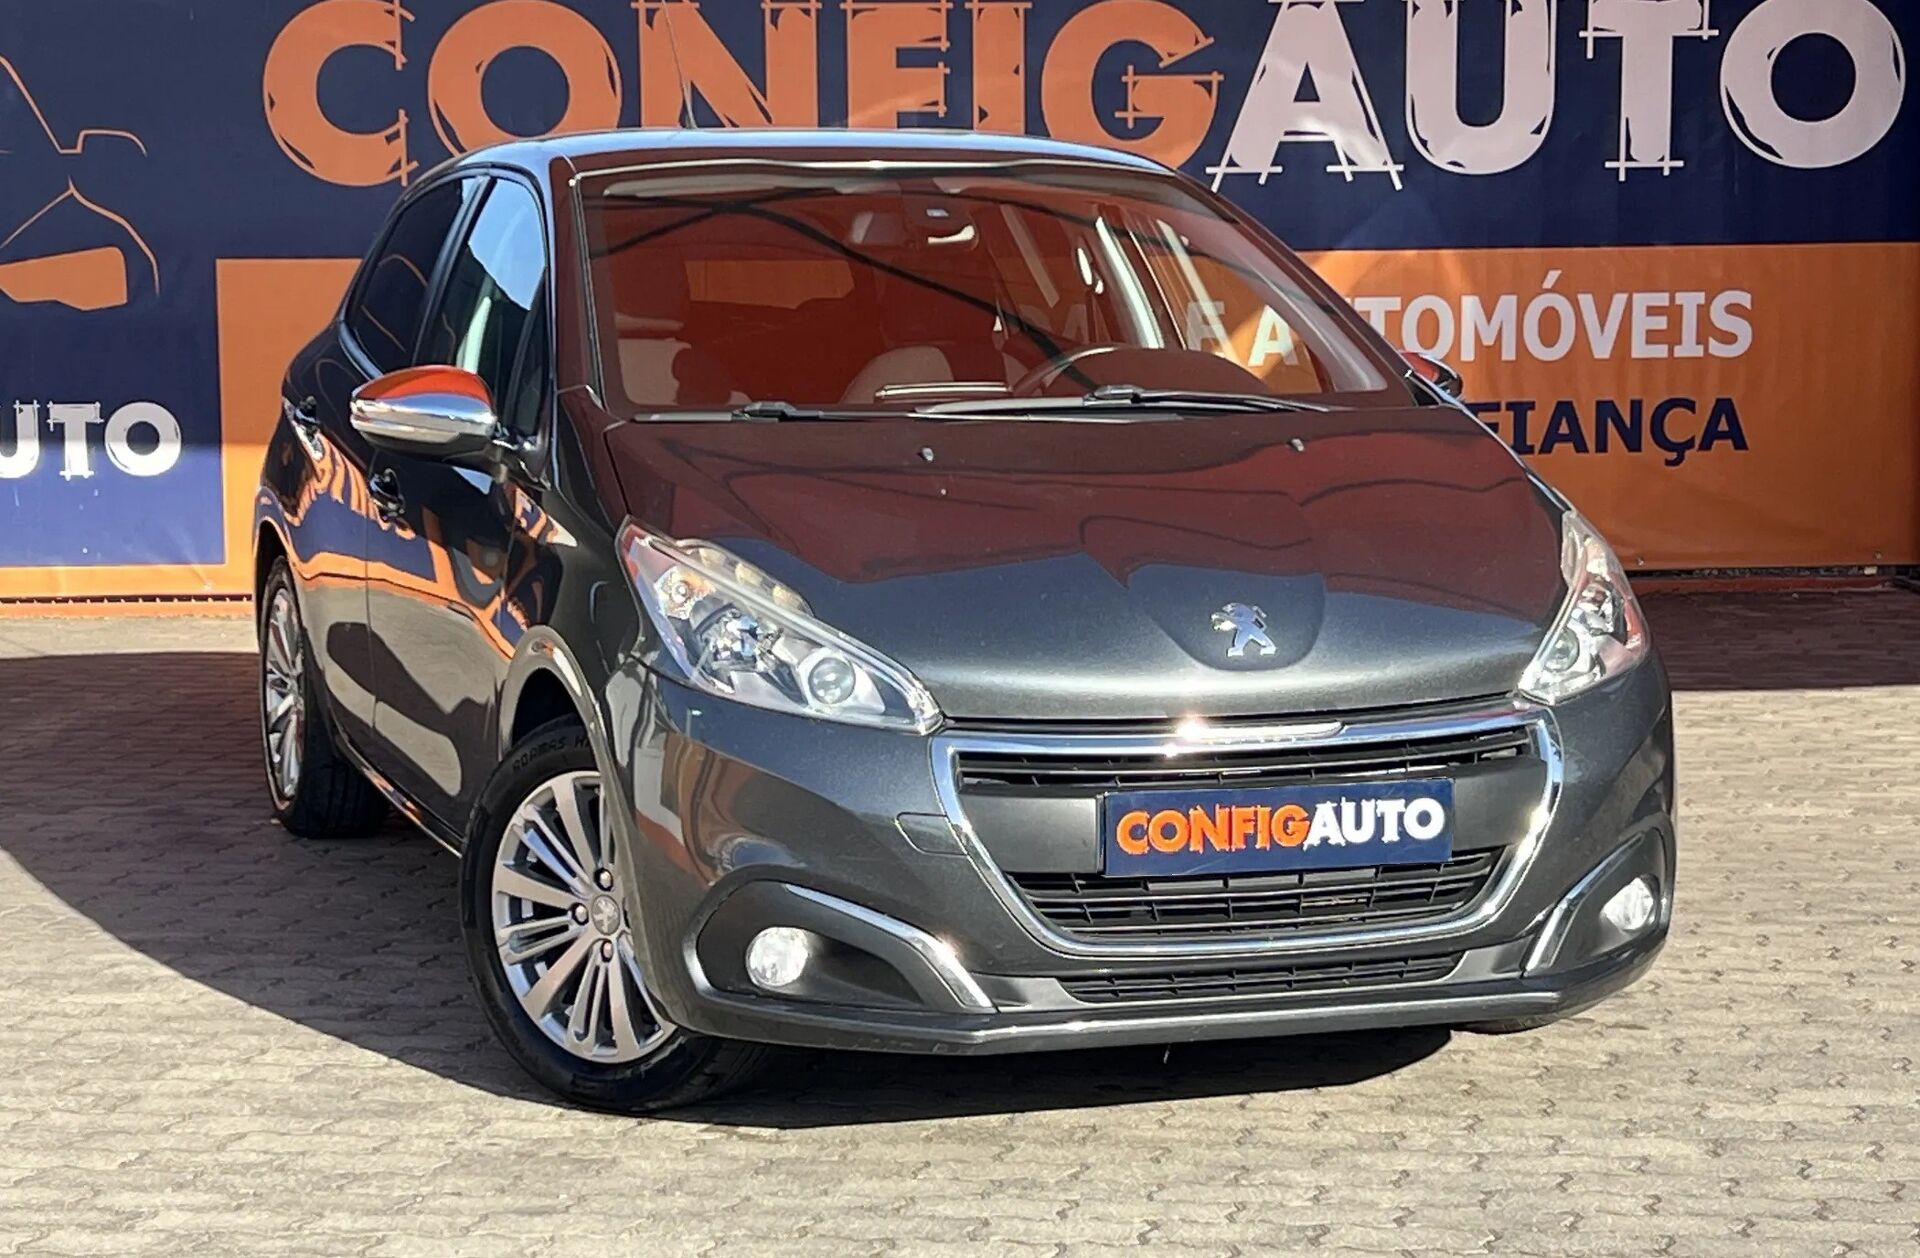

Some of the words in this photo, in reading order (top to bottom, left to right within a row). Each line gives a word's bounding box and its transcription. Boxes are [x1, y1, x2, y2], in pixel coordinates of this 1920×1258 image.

[1247, 269, 1754, 368] ATOMÓVEIS
[0, 399, 182, 481] UTO
[1464, 397, 1750, 467] FIANÇA
[1115, 796, 1446, 855] CONFIGAUTO
